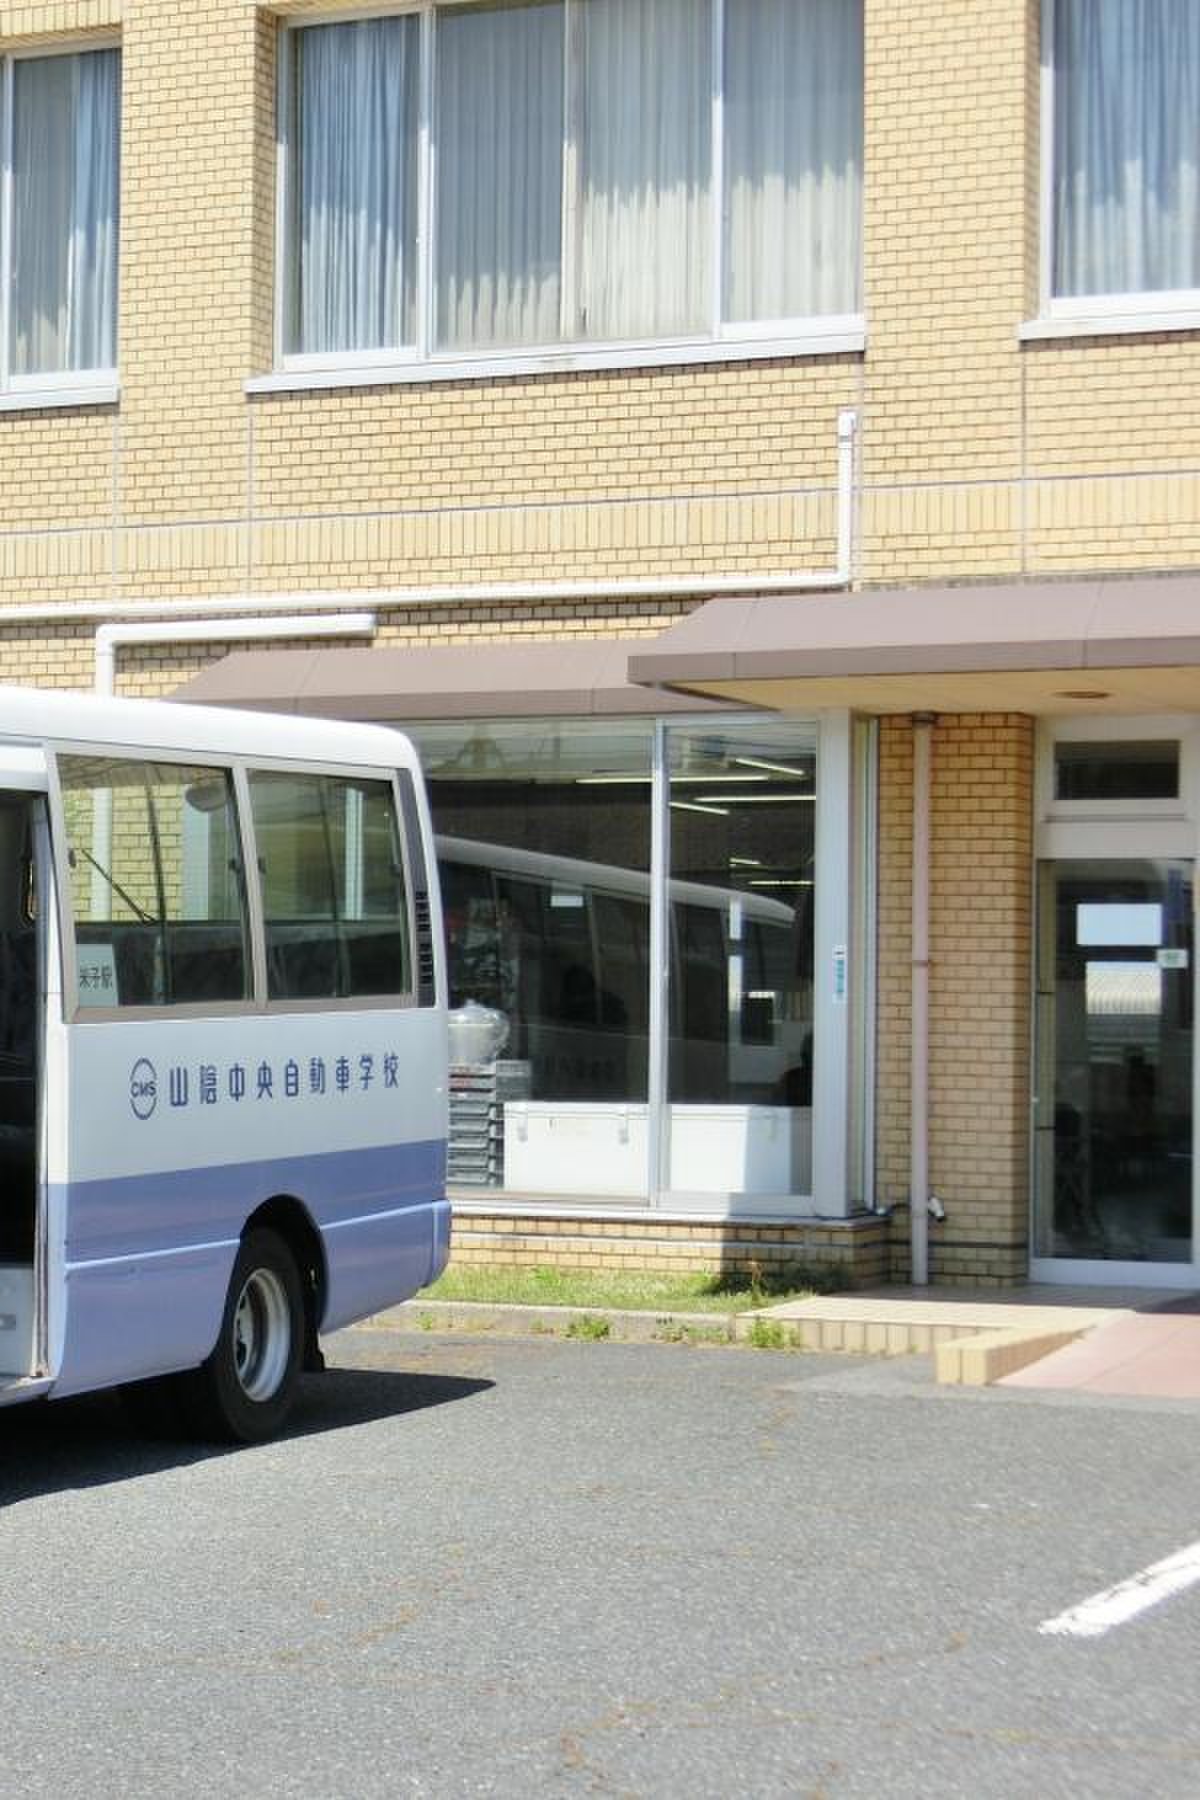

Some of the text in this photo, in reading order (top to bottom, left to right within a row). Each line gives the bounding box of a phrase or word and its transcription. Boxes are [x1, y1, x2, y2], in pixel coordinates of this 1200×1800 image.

[169, 1051, 399, 1107] 山陰中央自動車学校
